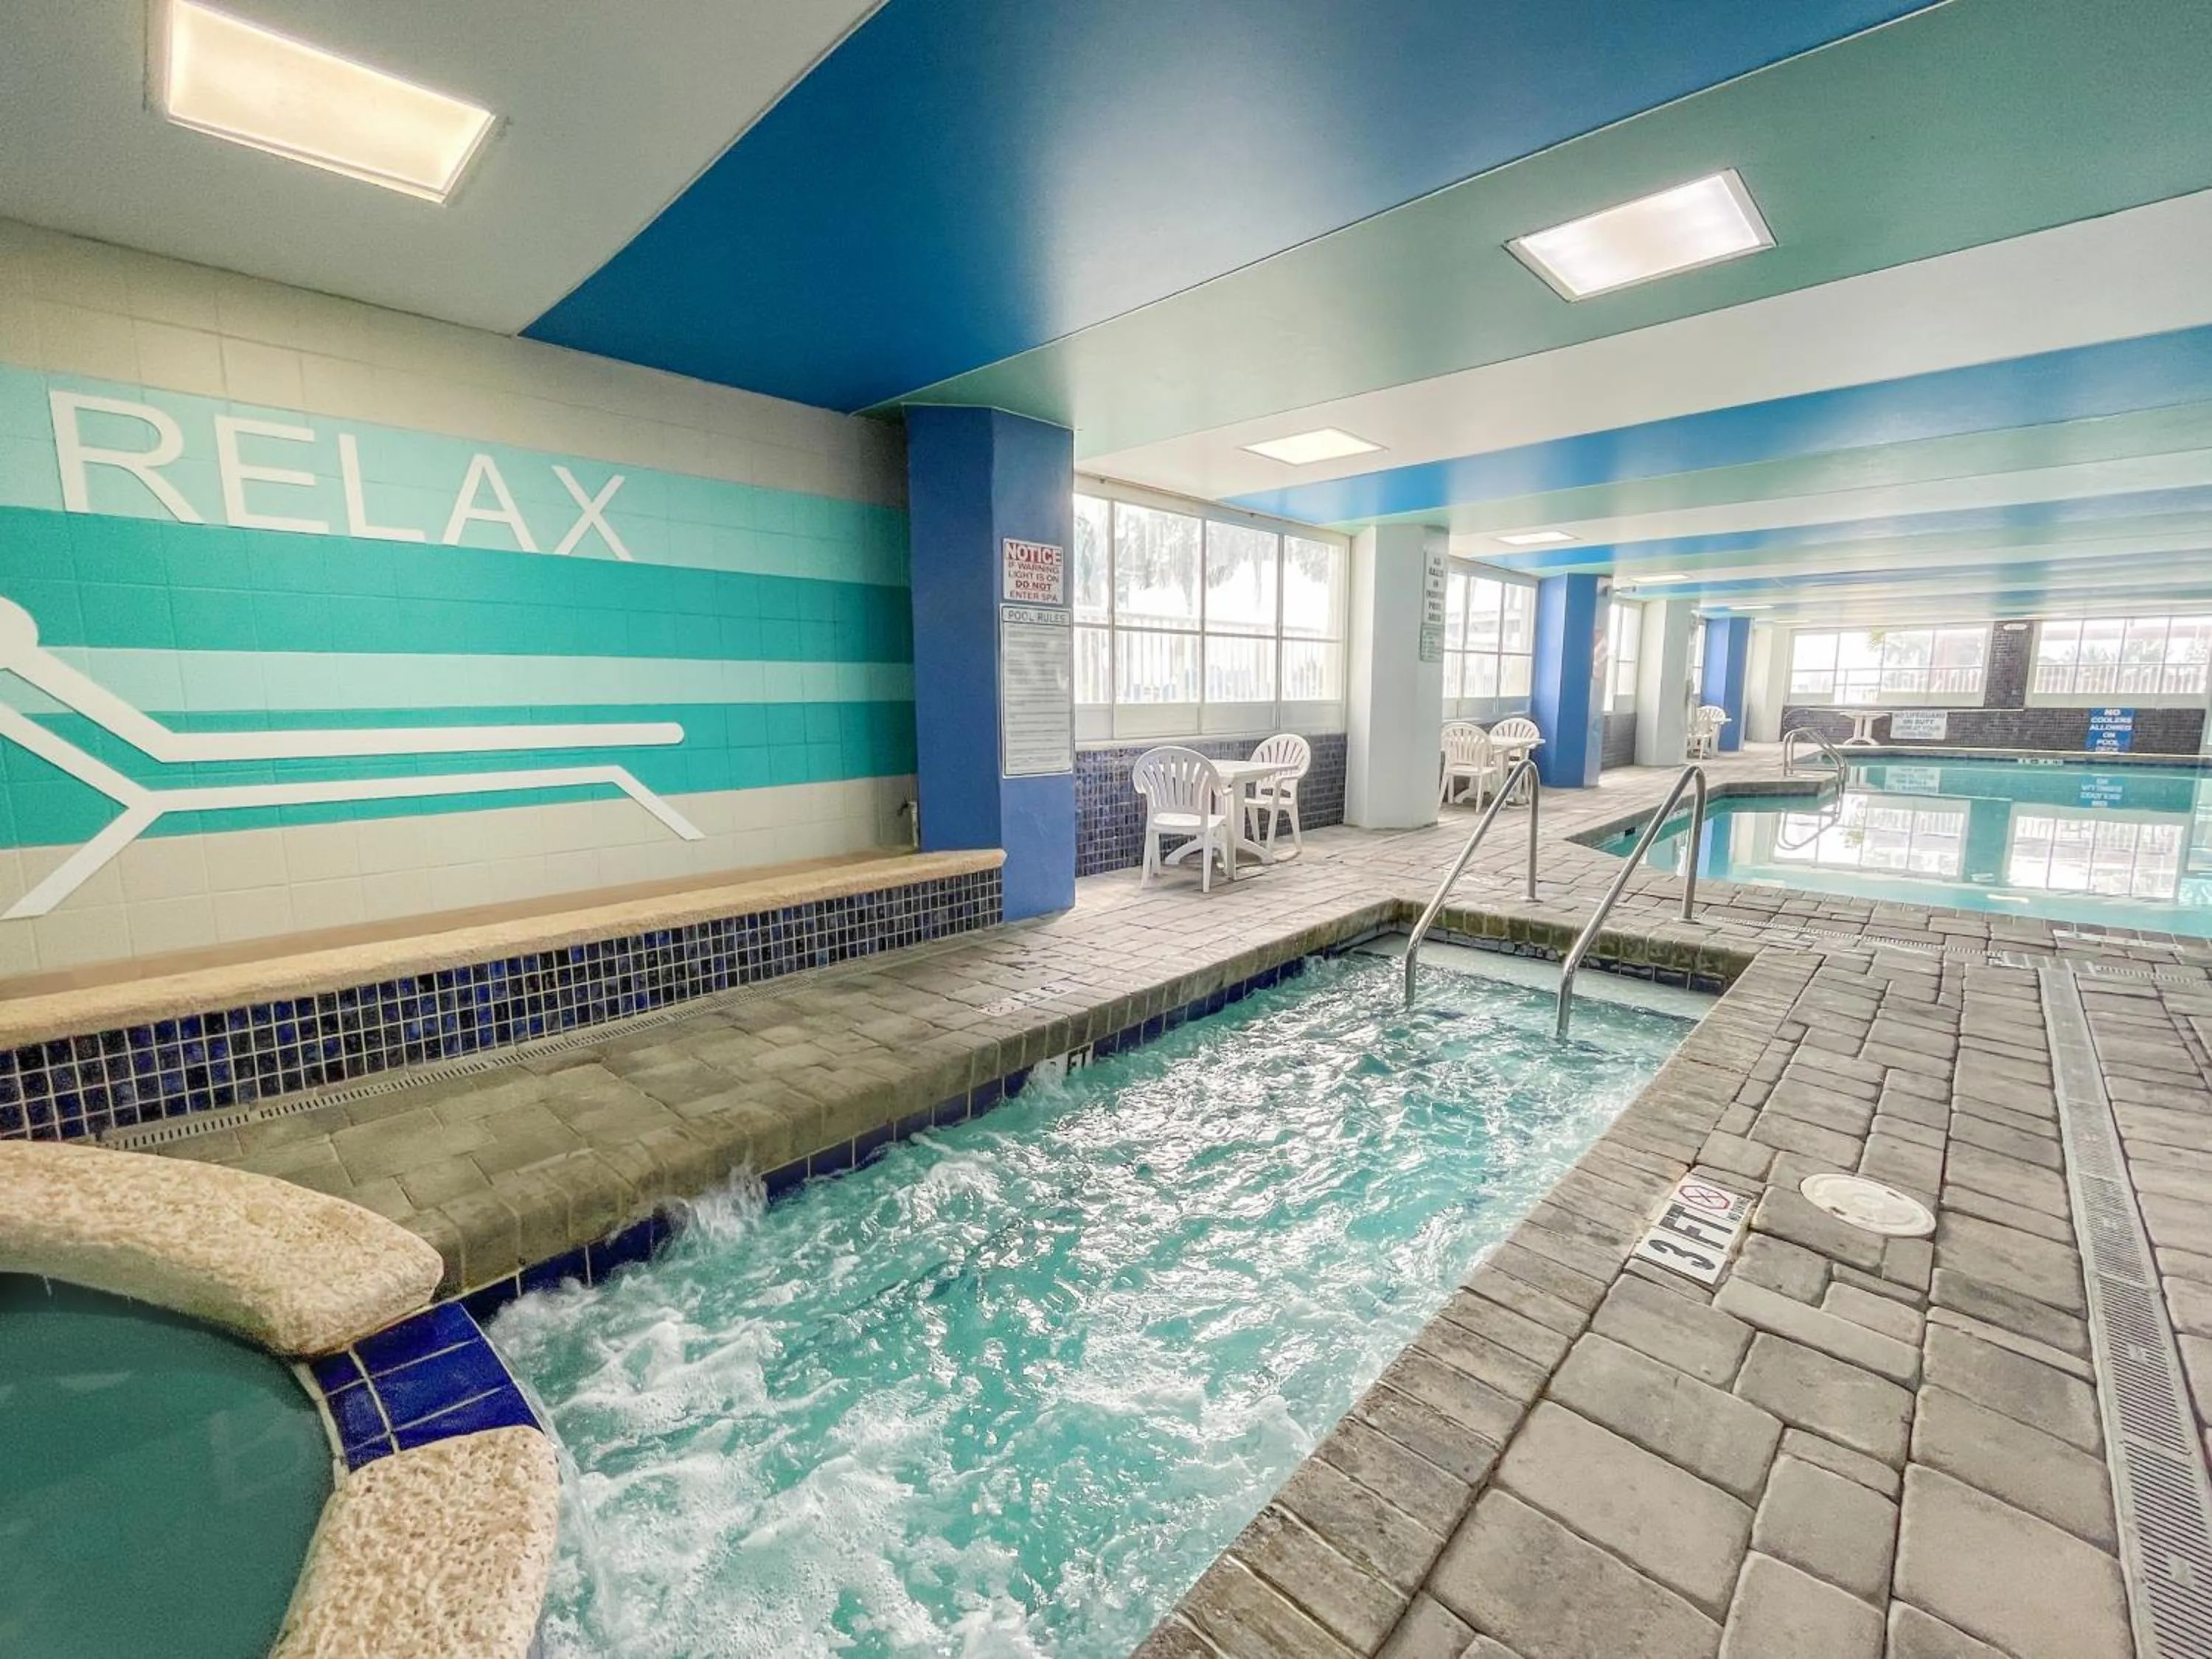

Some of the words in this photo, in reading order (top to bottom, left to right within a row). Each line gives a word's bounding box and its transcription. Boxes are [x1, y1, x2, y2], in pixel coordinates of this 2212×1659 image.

[49, 390, 633, 562] RELAX
[1006, 543, 1062, 565] NOTICE
[1008, 571, 1034, 580] LIGHT
[1036, 573, 1045, 582] IS
[1046, 574, 1059, 583] ON
[1018, 563, 1060, 574] WARNING
[1015, 580, 1030, 588] DO
[1032, 582, 1051, 591] NOT
[1009, 591, 1039, 599] ENTER
[1041, 592, 1058, 602] SPA
[1008, 611, 1034, 621] POOL
[1037, 613, 1065, 623] RULES
[1066, 1043, 1091, 1076] FT
[1659, 1203, 1733, 1250] FT
[1648, 1239, 1716, 1270] 3
